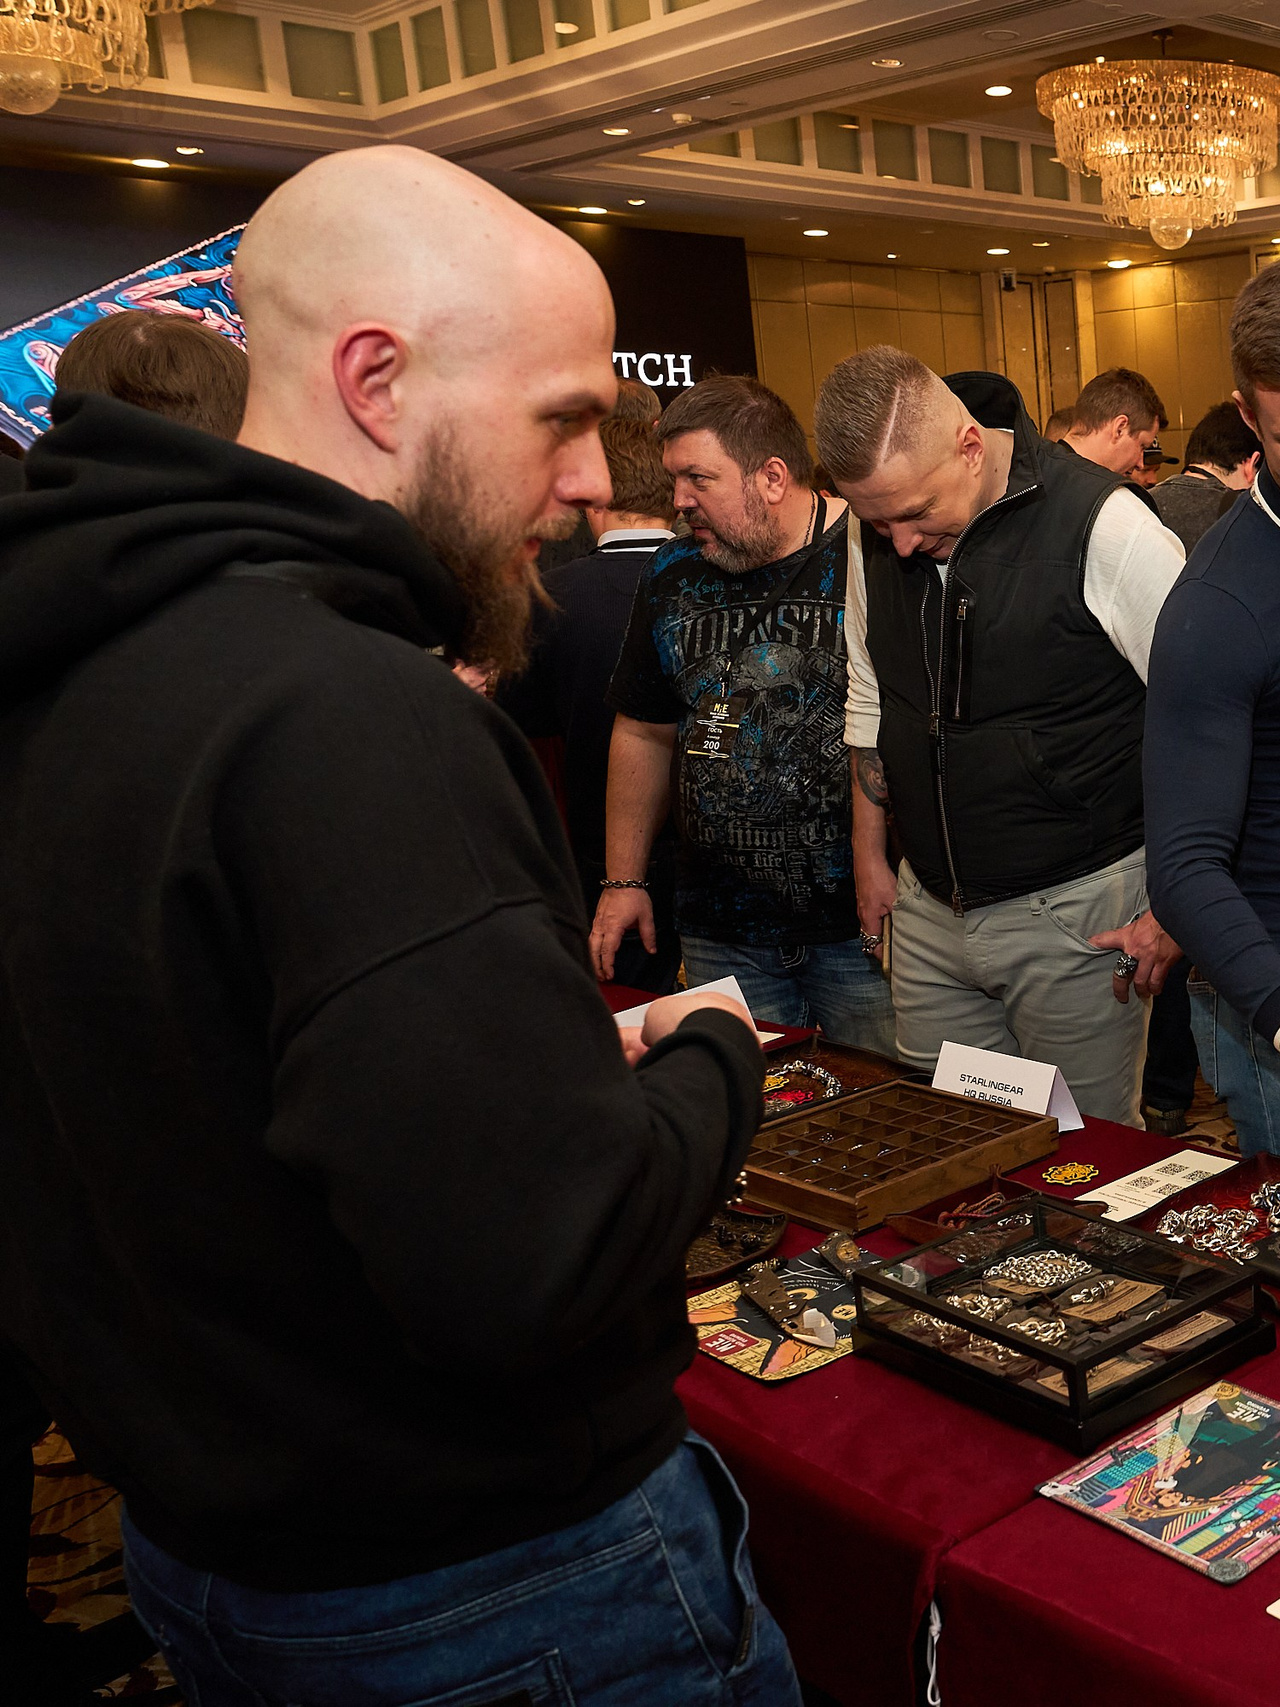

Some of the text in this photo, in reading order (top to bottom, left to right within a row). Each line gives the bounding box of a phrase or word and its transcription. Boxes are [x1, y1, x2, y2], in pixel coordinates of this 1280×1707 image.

[612, 351, 695, 387] TCH
[703, 740, 720, 750] 200
[959, 1073, 1024, 1096] STARLINGEAR
[963, 1088, 1012, 1107] HQ RUSSIA
